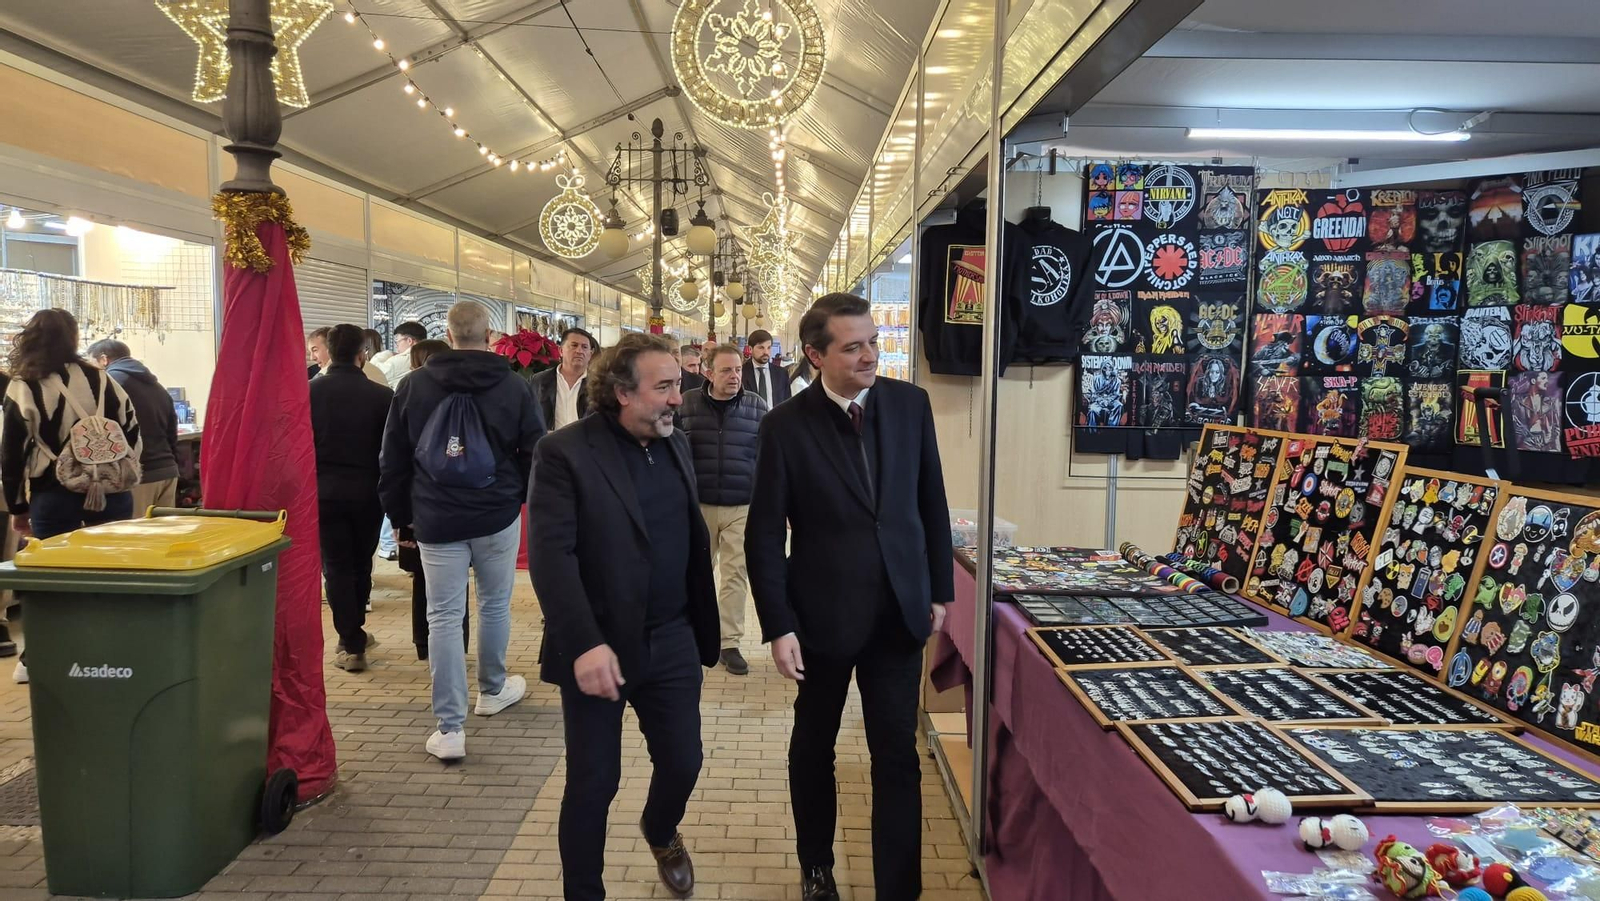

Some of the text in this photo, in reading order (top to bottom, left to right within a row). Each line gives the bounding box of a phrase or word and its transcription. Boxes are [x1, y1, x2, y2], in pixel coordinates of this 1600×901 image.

[1150, 187, 1187, 200] NIRVANA
[1261, 188, 1309, 207] ANTHRAX
[1276, 207, 1300, 221] NOT
[1144, 233, 1186, 267] PEPPERS
[1575, 236, 1600, 257] KI
[1184, 242, 1198, 269] RED
[1261, 251, 1306, 265] ANTHRAX
[1464, 306, 1511, 320] PANTERA
[1256, 375, 1299, 393] SLAYER
[1323, 376, 1357, 388] SKA-P
[1564, 424, 1600, 441] PUB
[1569, 443, 1600, 457] ENE
[83, 663, 133, 678] sadeco
[1581, 721, 1600, 734] STA
[1575, 726, 1600, 746] WAR
